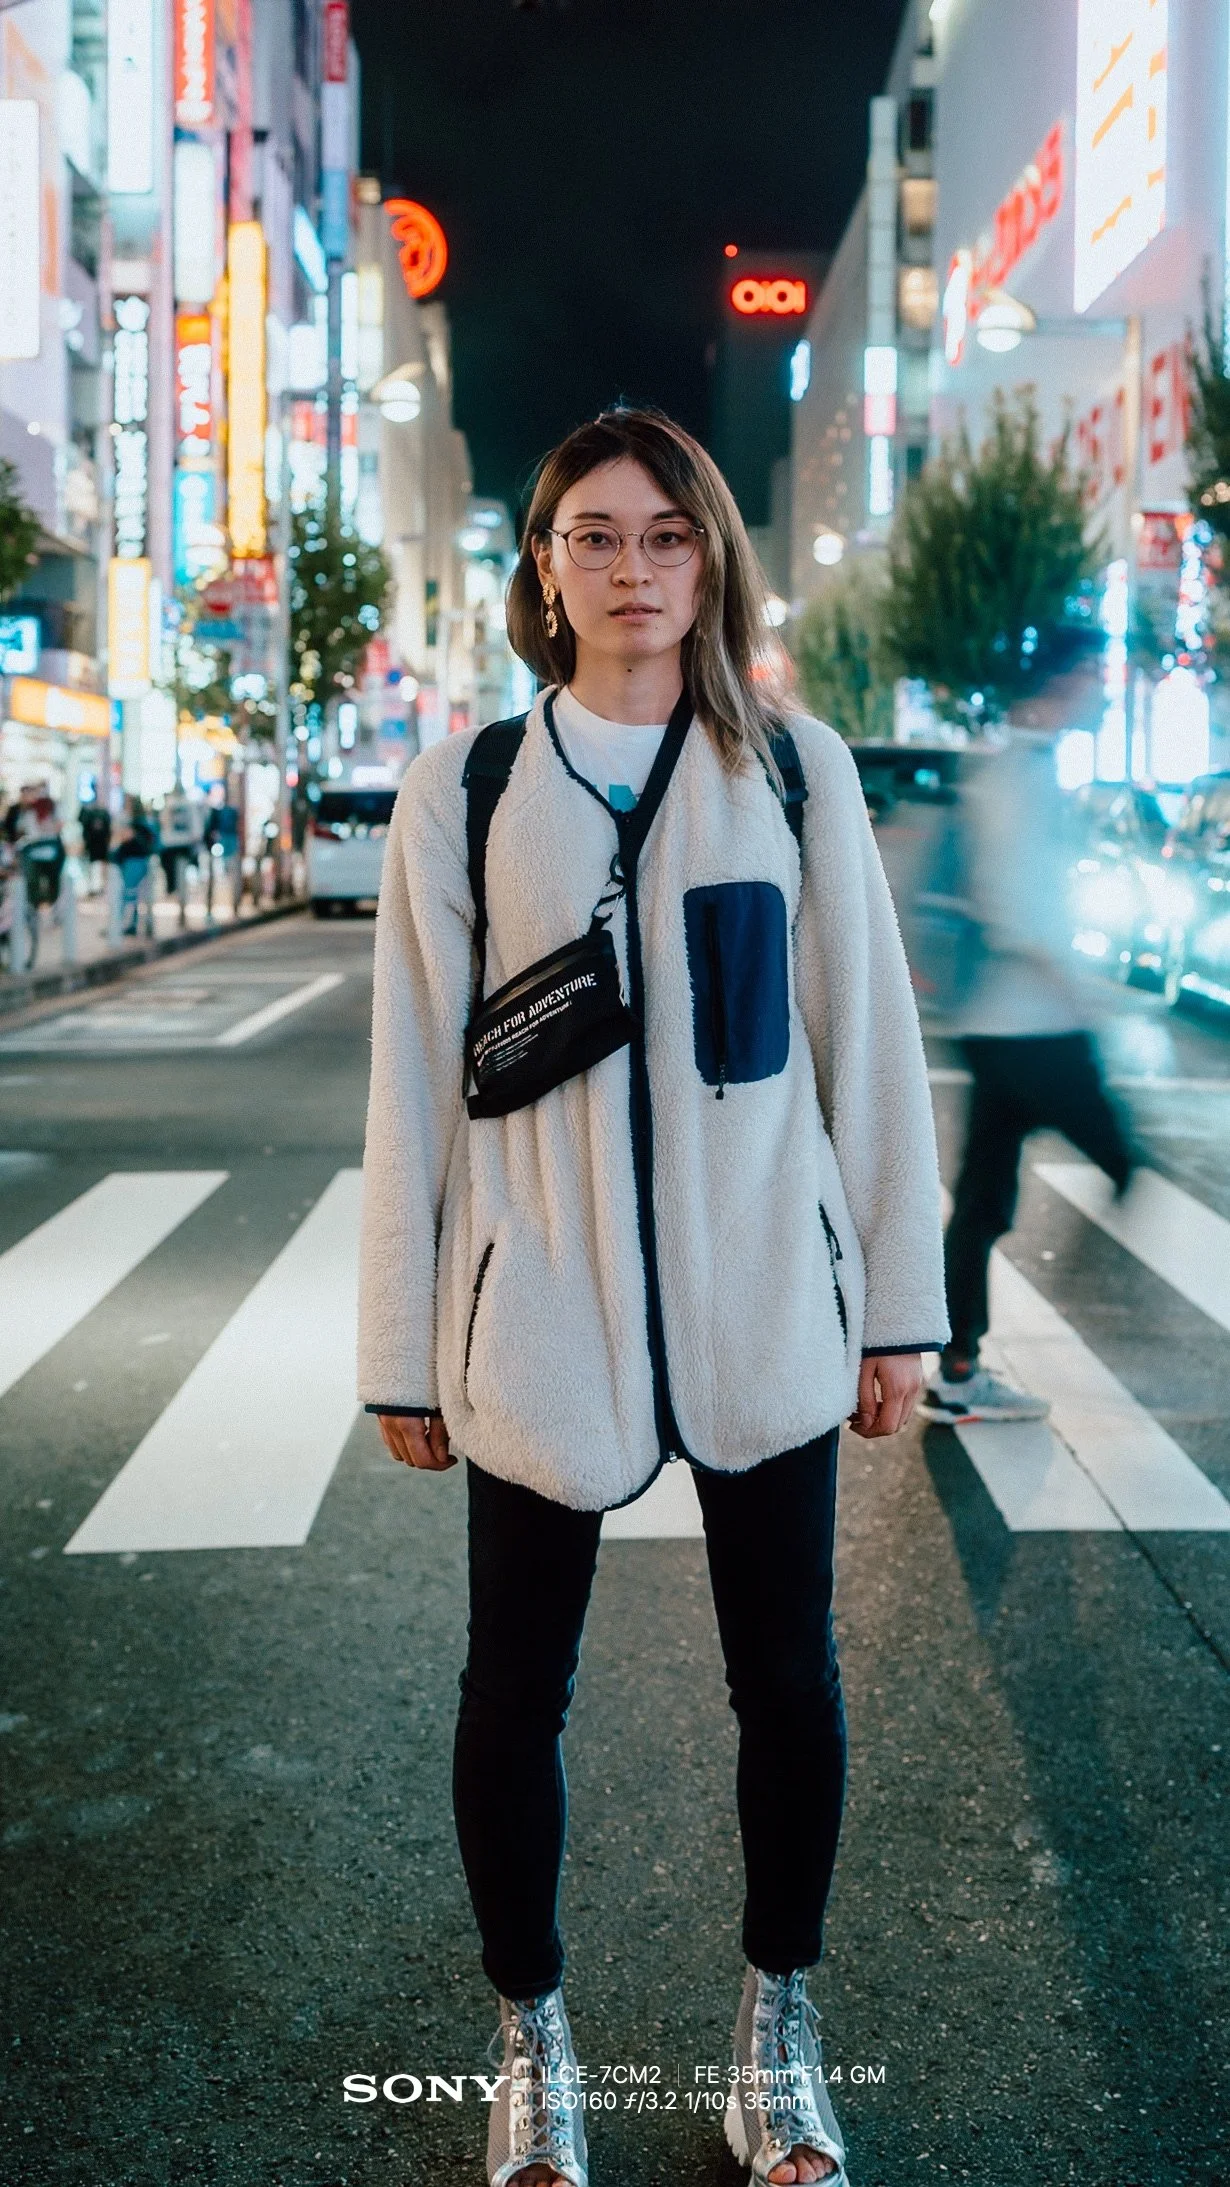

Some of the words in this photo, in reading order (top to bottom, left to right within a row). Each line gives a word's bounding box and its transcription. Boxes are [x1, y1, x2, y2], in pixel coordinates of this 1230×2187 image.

[503, 1011, 526, 1033] FOR
[528, 973, 597, 1018] ADVENTURE
[529, 1019, 540, 1030] FOR
